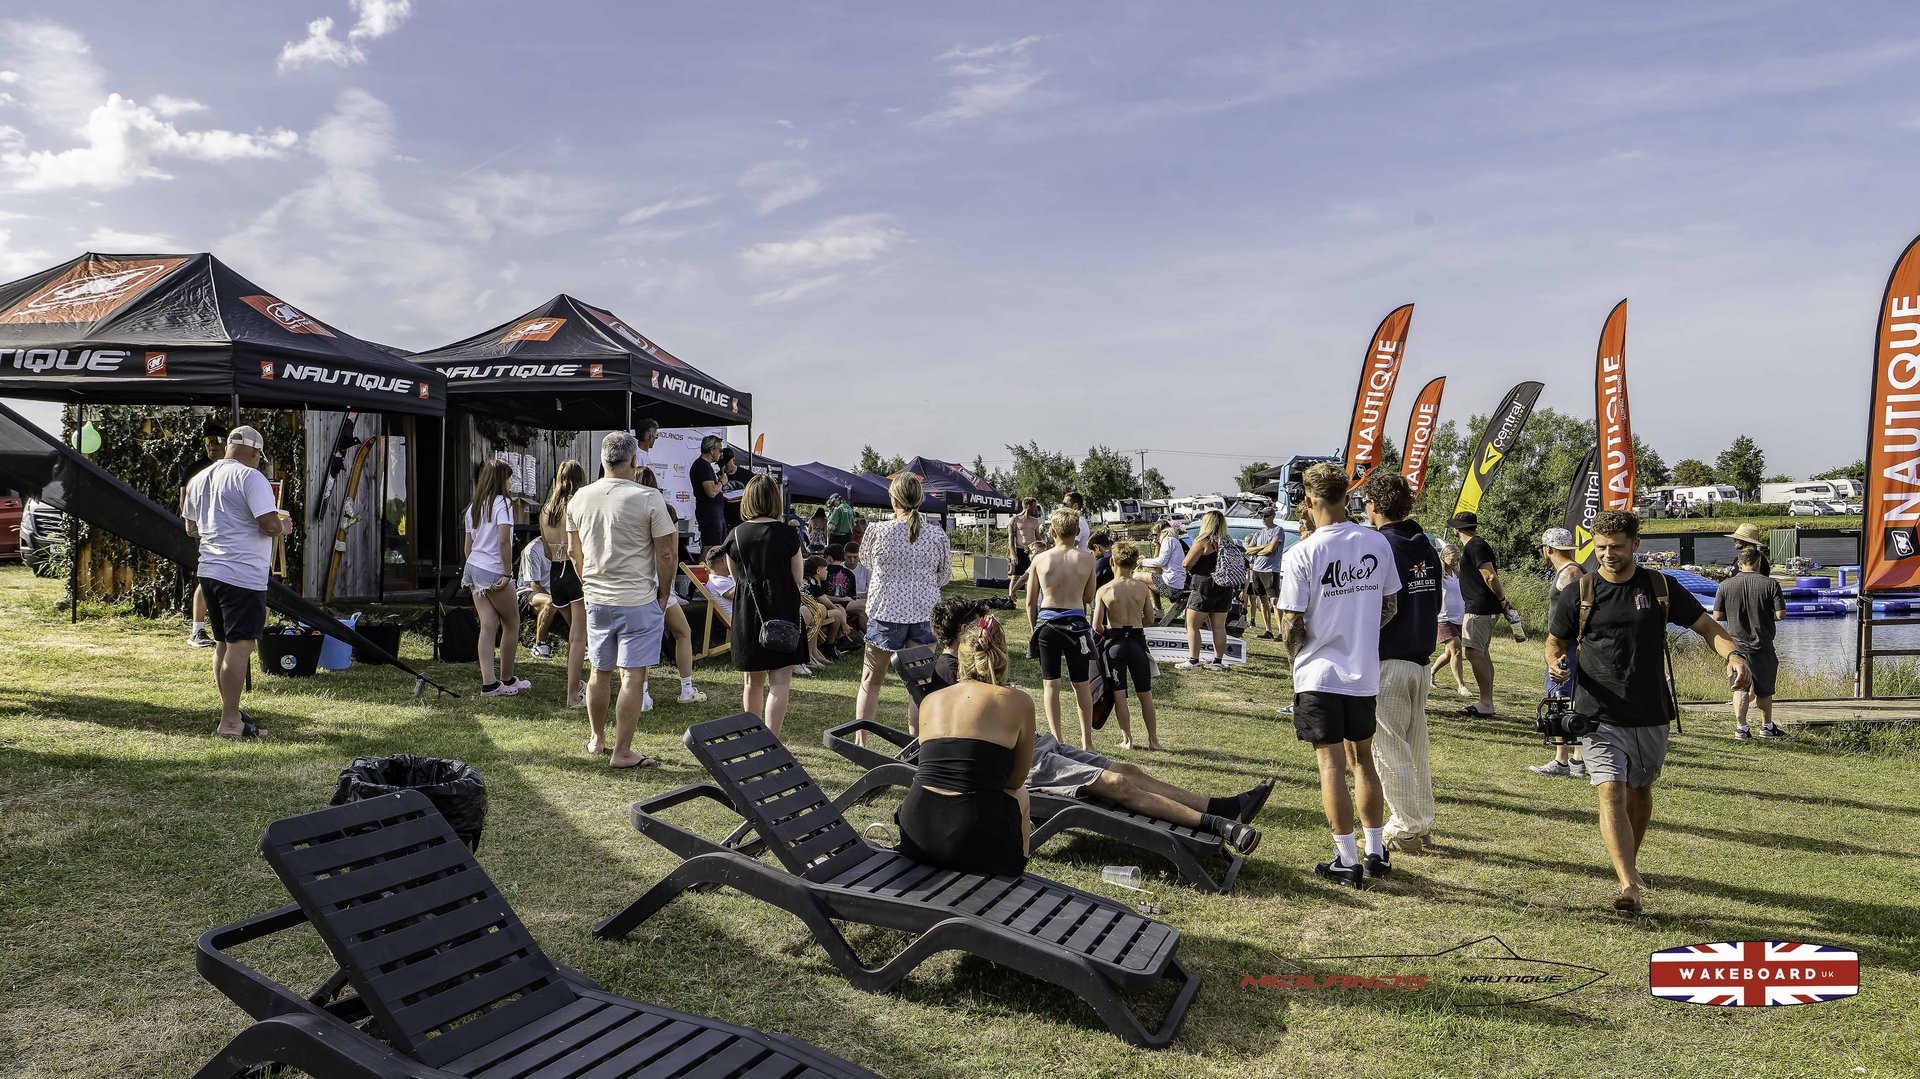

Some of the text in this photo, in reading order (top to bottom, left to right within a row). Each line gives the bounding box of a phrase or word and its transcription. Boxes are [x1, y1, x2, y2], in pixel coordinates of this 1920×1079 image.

[282, 363, 413, 393] NAUTIQUE
[662, 374, 730, 407] NAUTIQUE
[1355, 339, 1397, 461] NAUTIQUE
[1883, 295, 1920, 522] NAUTIQUE
[1493, 401, 1522, 448] central
[970, 493, 1013, 508] NAUTIQUE
[1355, 583, 1379, 593] School
[1147, 640, 1178, 648] QUID
